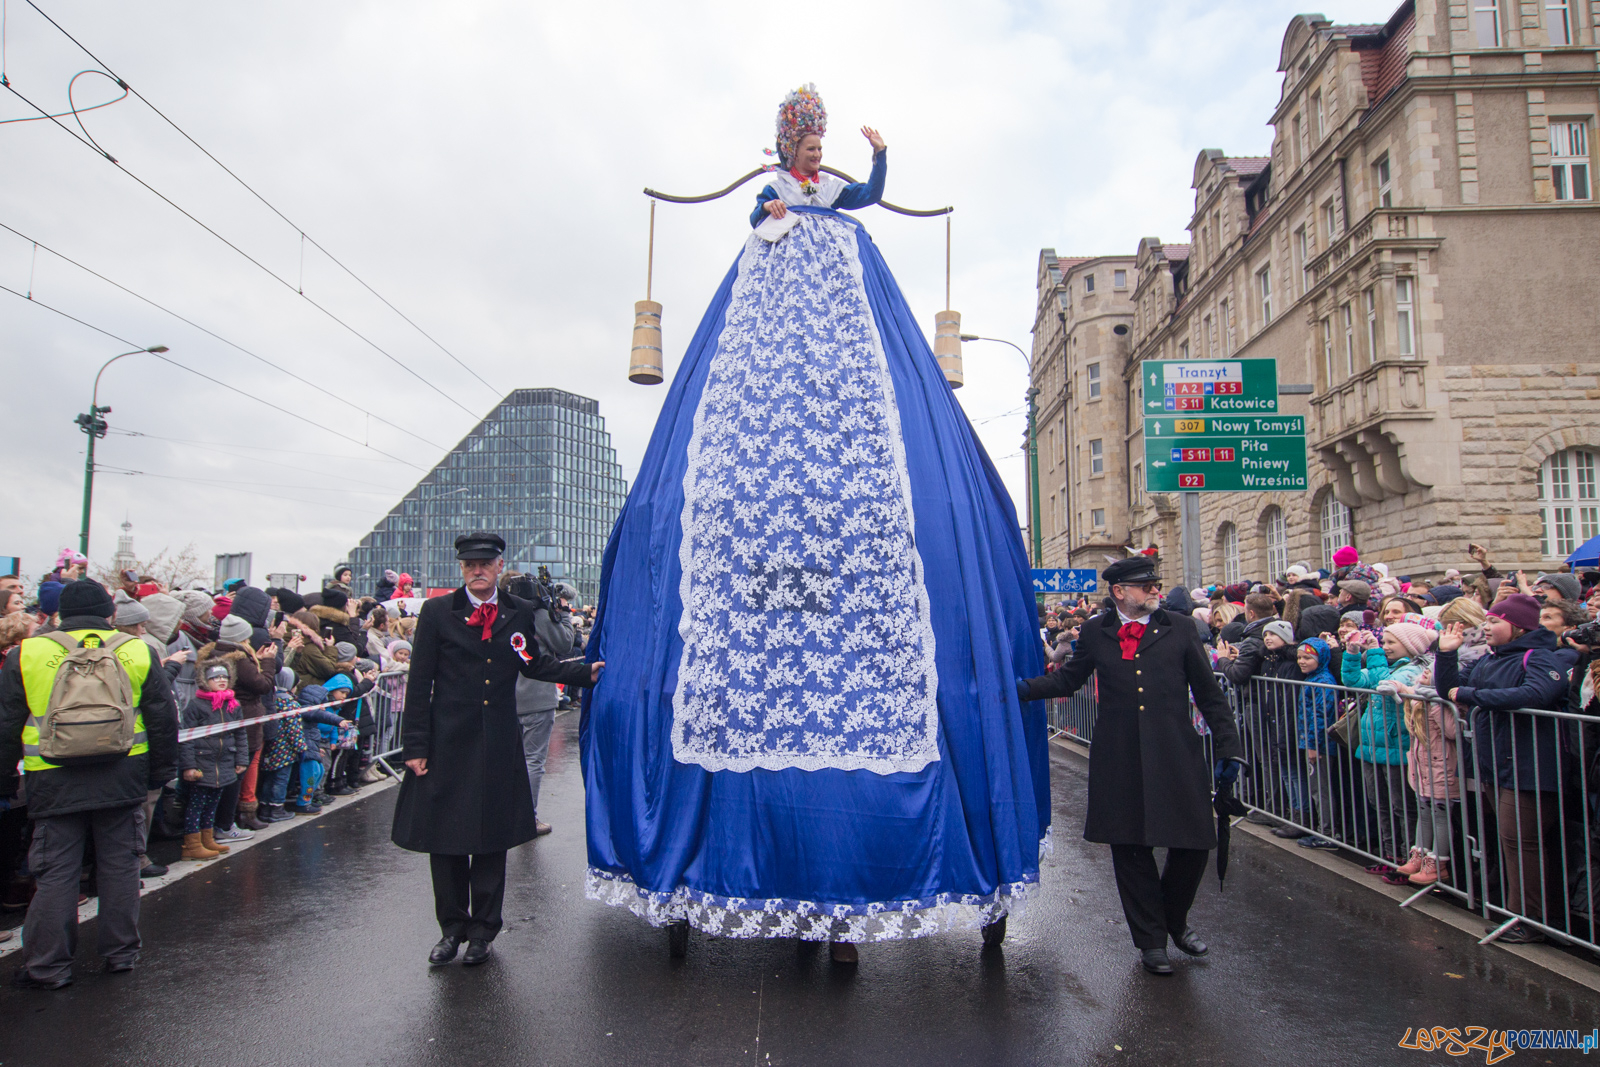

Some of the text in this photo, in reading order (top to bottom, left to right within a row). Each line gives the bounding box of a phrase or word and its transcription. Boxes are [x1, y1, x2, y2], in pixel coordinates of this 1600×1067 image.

[1178, 366, 1228, 380] Tranzyt
[1181, 383, 1236, 393] A 2 S 5
[1181, 397, 1276, 409] S 11 Katowice
[1180, 418, 1302, 434] 307 Nowy Tomyśl
[1241, 439, 1269, 452] Piła
[1188, 450, 1229, 460] S 11 11
[1241, 457, 1290, 472] Pniewy
[1185, 476, 1199, 486] 92
[1241, 474, 1305, 486] Września
